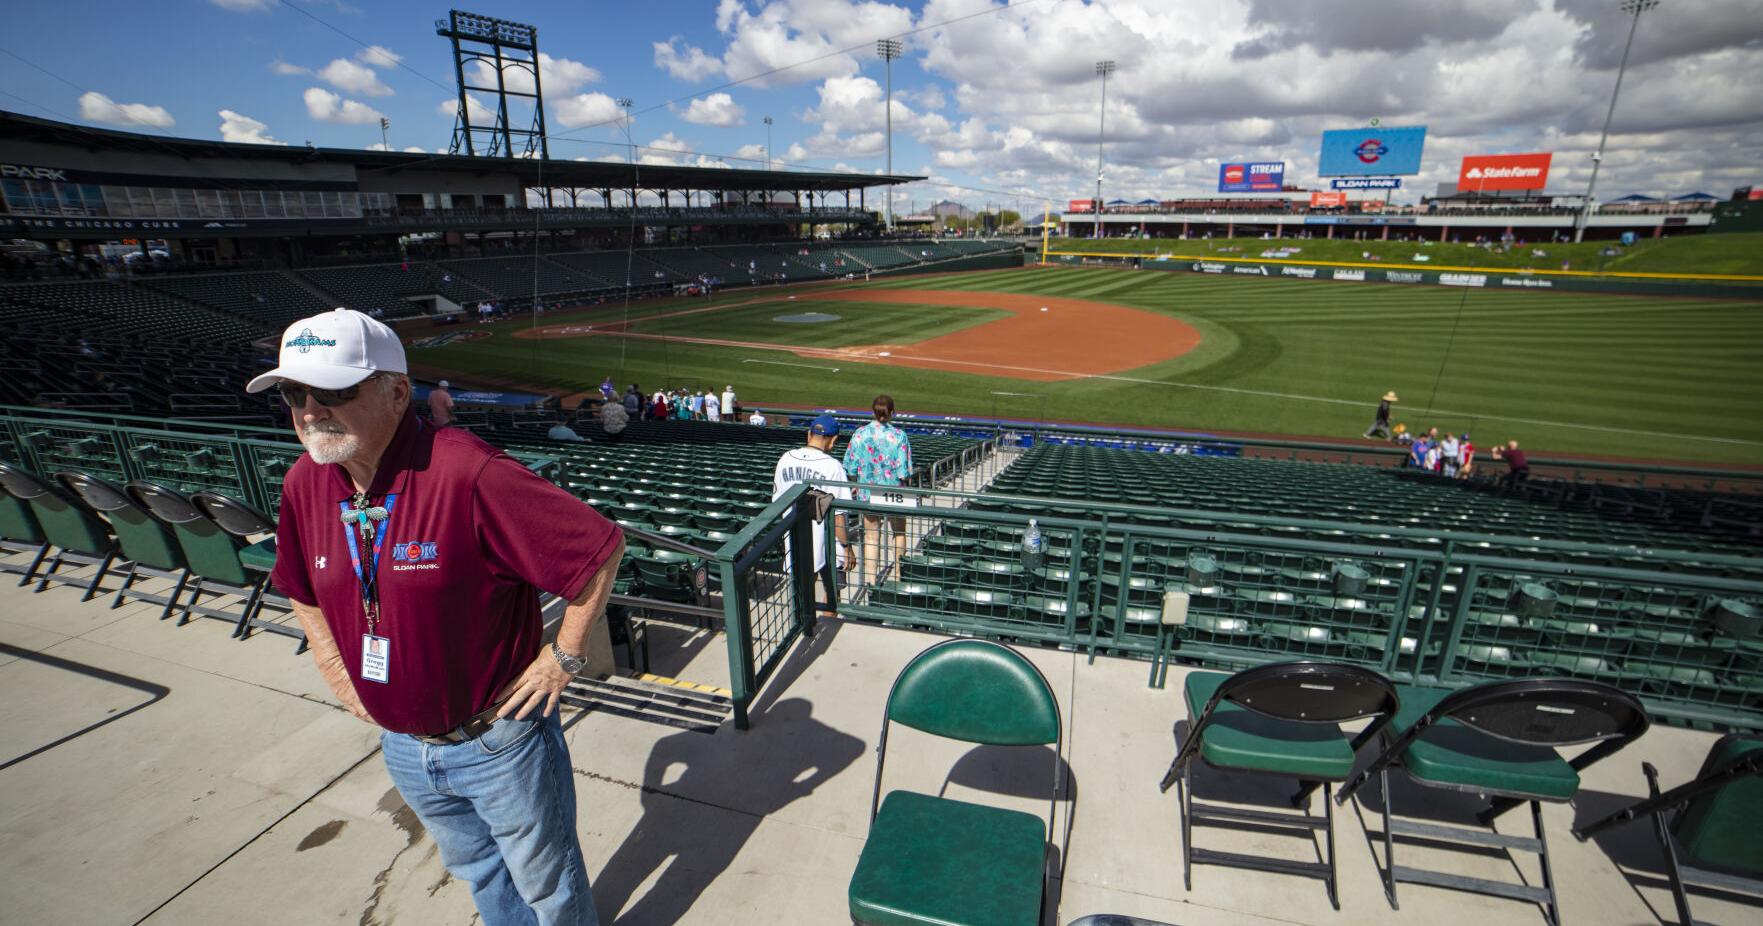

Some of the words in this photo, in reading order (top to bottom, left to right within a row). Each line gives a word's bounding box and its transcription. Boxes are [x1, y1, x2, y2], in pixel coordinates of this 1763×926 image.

[0, 164, 67, 181] PARK
[1250, 164, 1283, 174] STREAM
[1336, 180, 1369, 188] SLOAN
[1369, 179, 1396, 187] PARK
[64, 220, 133, 229] CHICAGO
[142, 221, 179, 229] CUBS
[882, 492, 904, 504] 118
